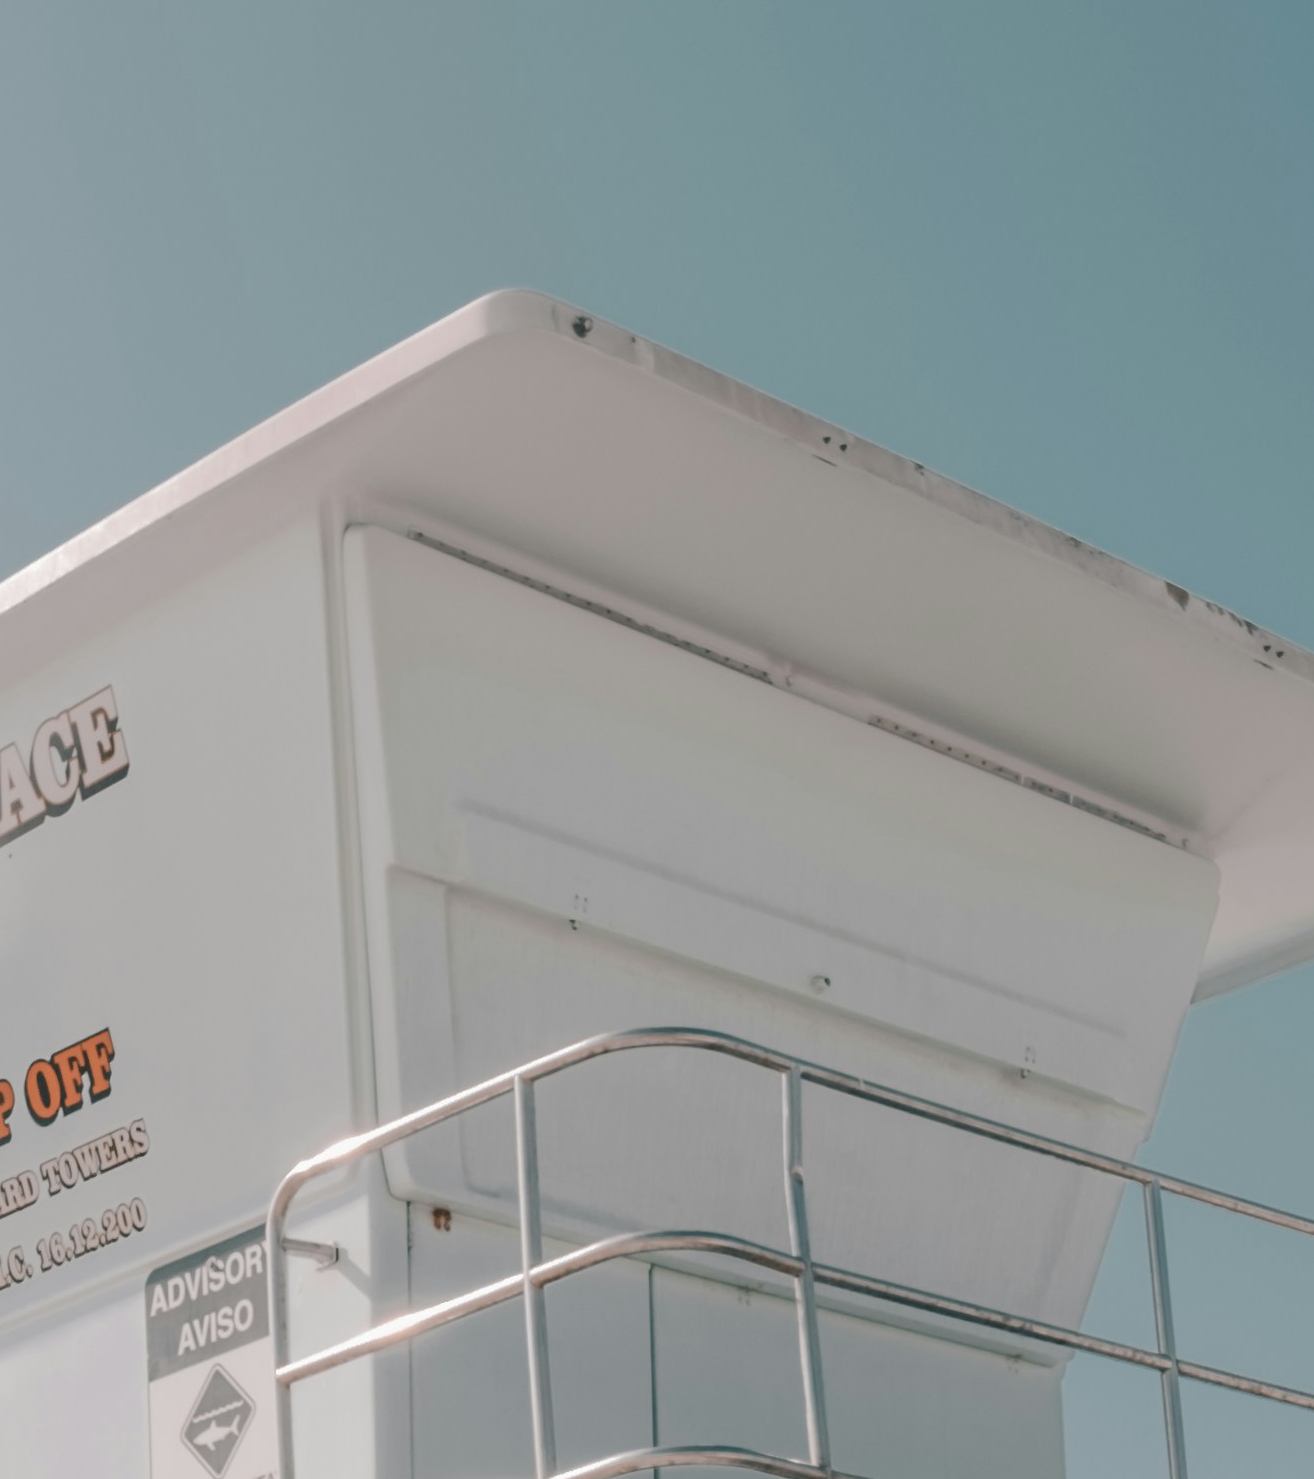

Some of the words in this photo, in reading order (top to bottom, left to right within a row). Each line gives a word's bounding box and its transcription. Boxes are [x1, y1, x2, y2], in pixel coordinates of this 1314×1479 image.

[25, 1027, 115, 1126] OFF
[40, 1118, 149, 1196] TOWERS
[37, 1197, 148, 1272] 16.12.200
[177, 1298, 254, 1356] AVISO
